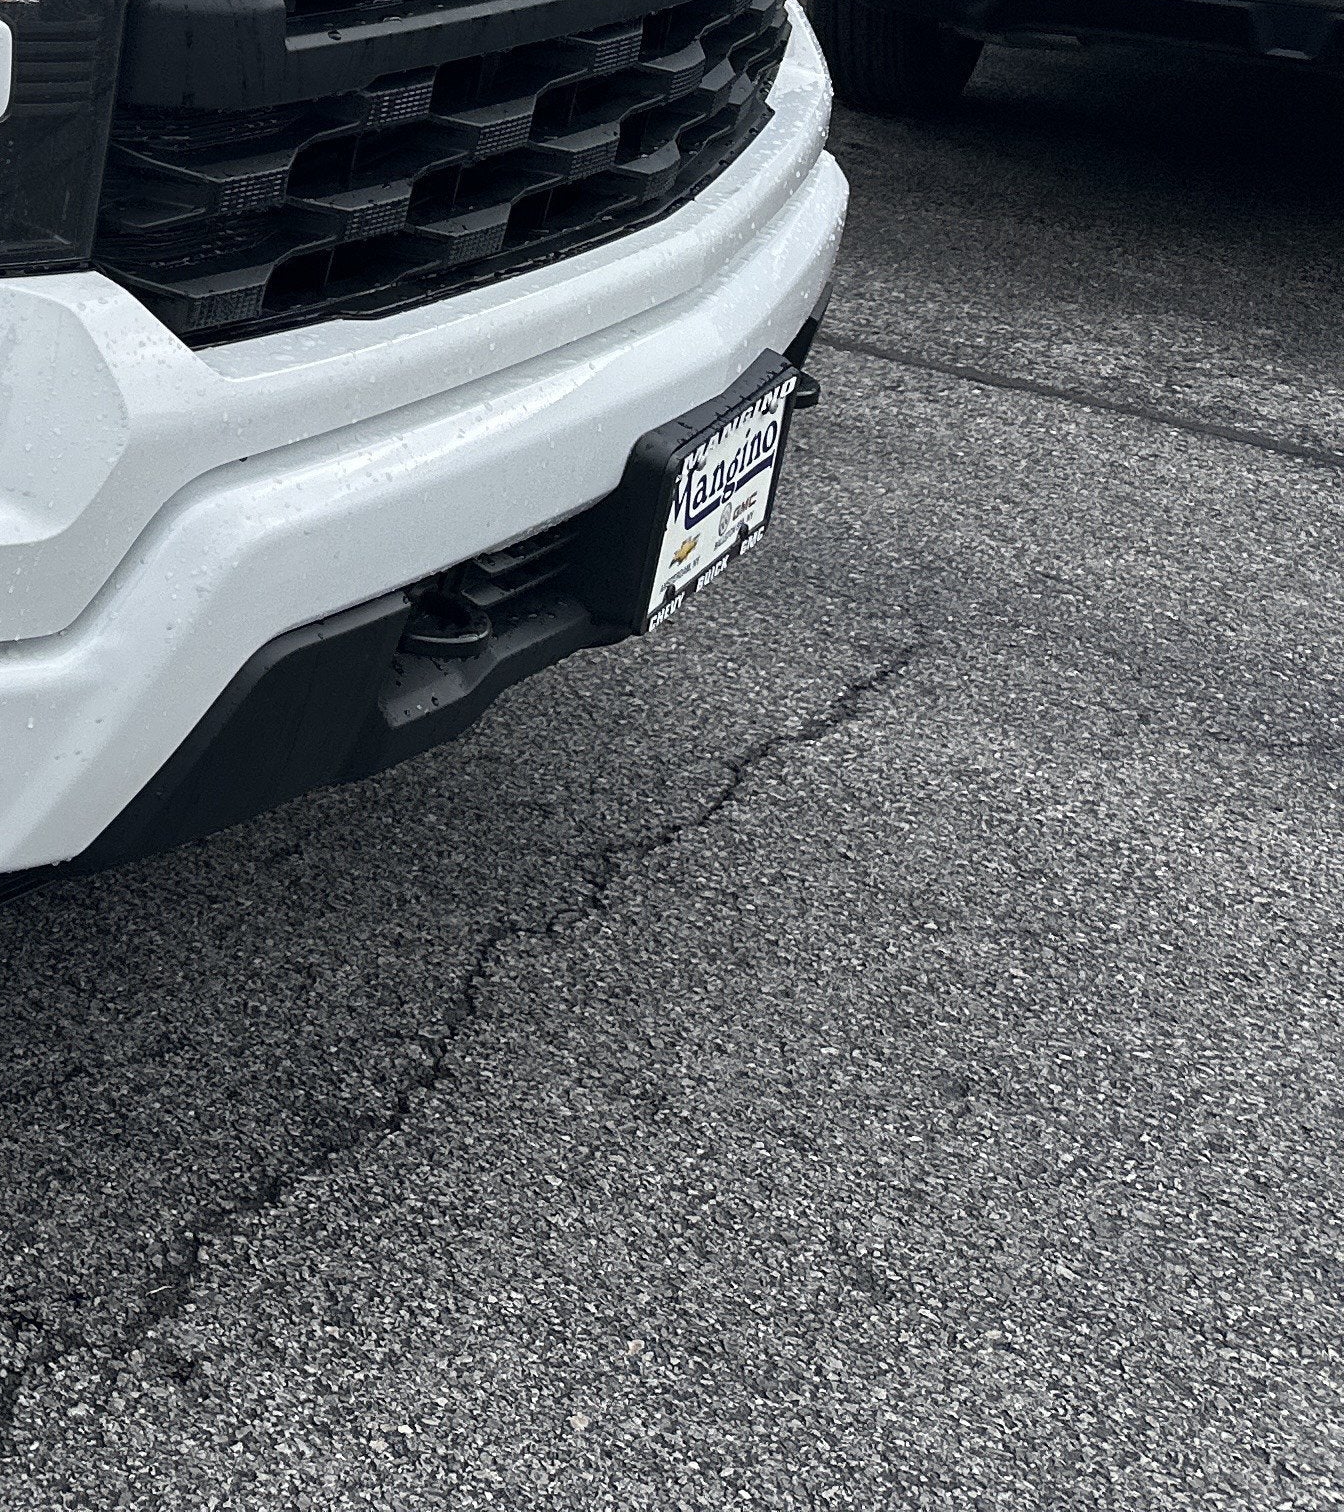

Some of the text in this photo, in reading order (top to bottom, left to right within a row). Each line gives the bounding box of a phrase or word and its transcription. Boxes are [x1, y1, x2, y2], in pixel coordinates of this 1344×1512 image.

[673, 420, 778, 531] Mangino
[732, 491, 758, 521] GMC
[648, 591, 686, 632] CHEVY
[695, 553, 730, 593] BUICK
[739, 525, 765, 556] GMC
